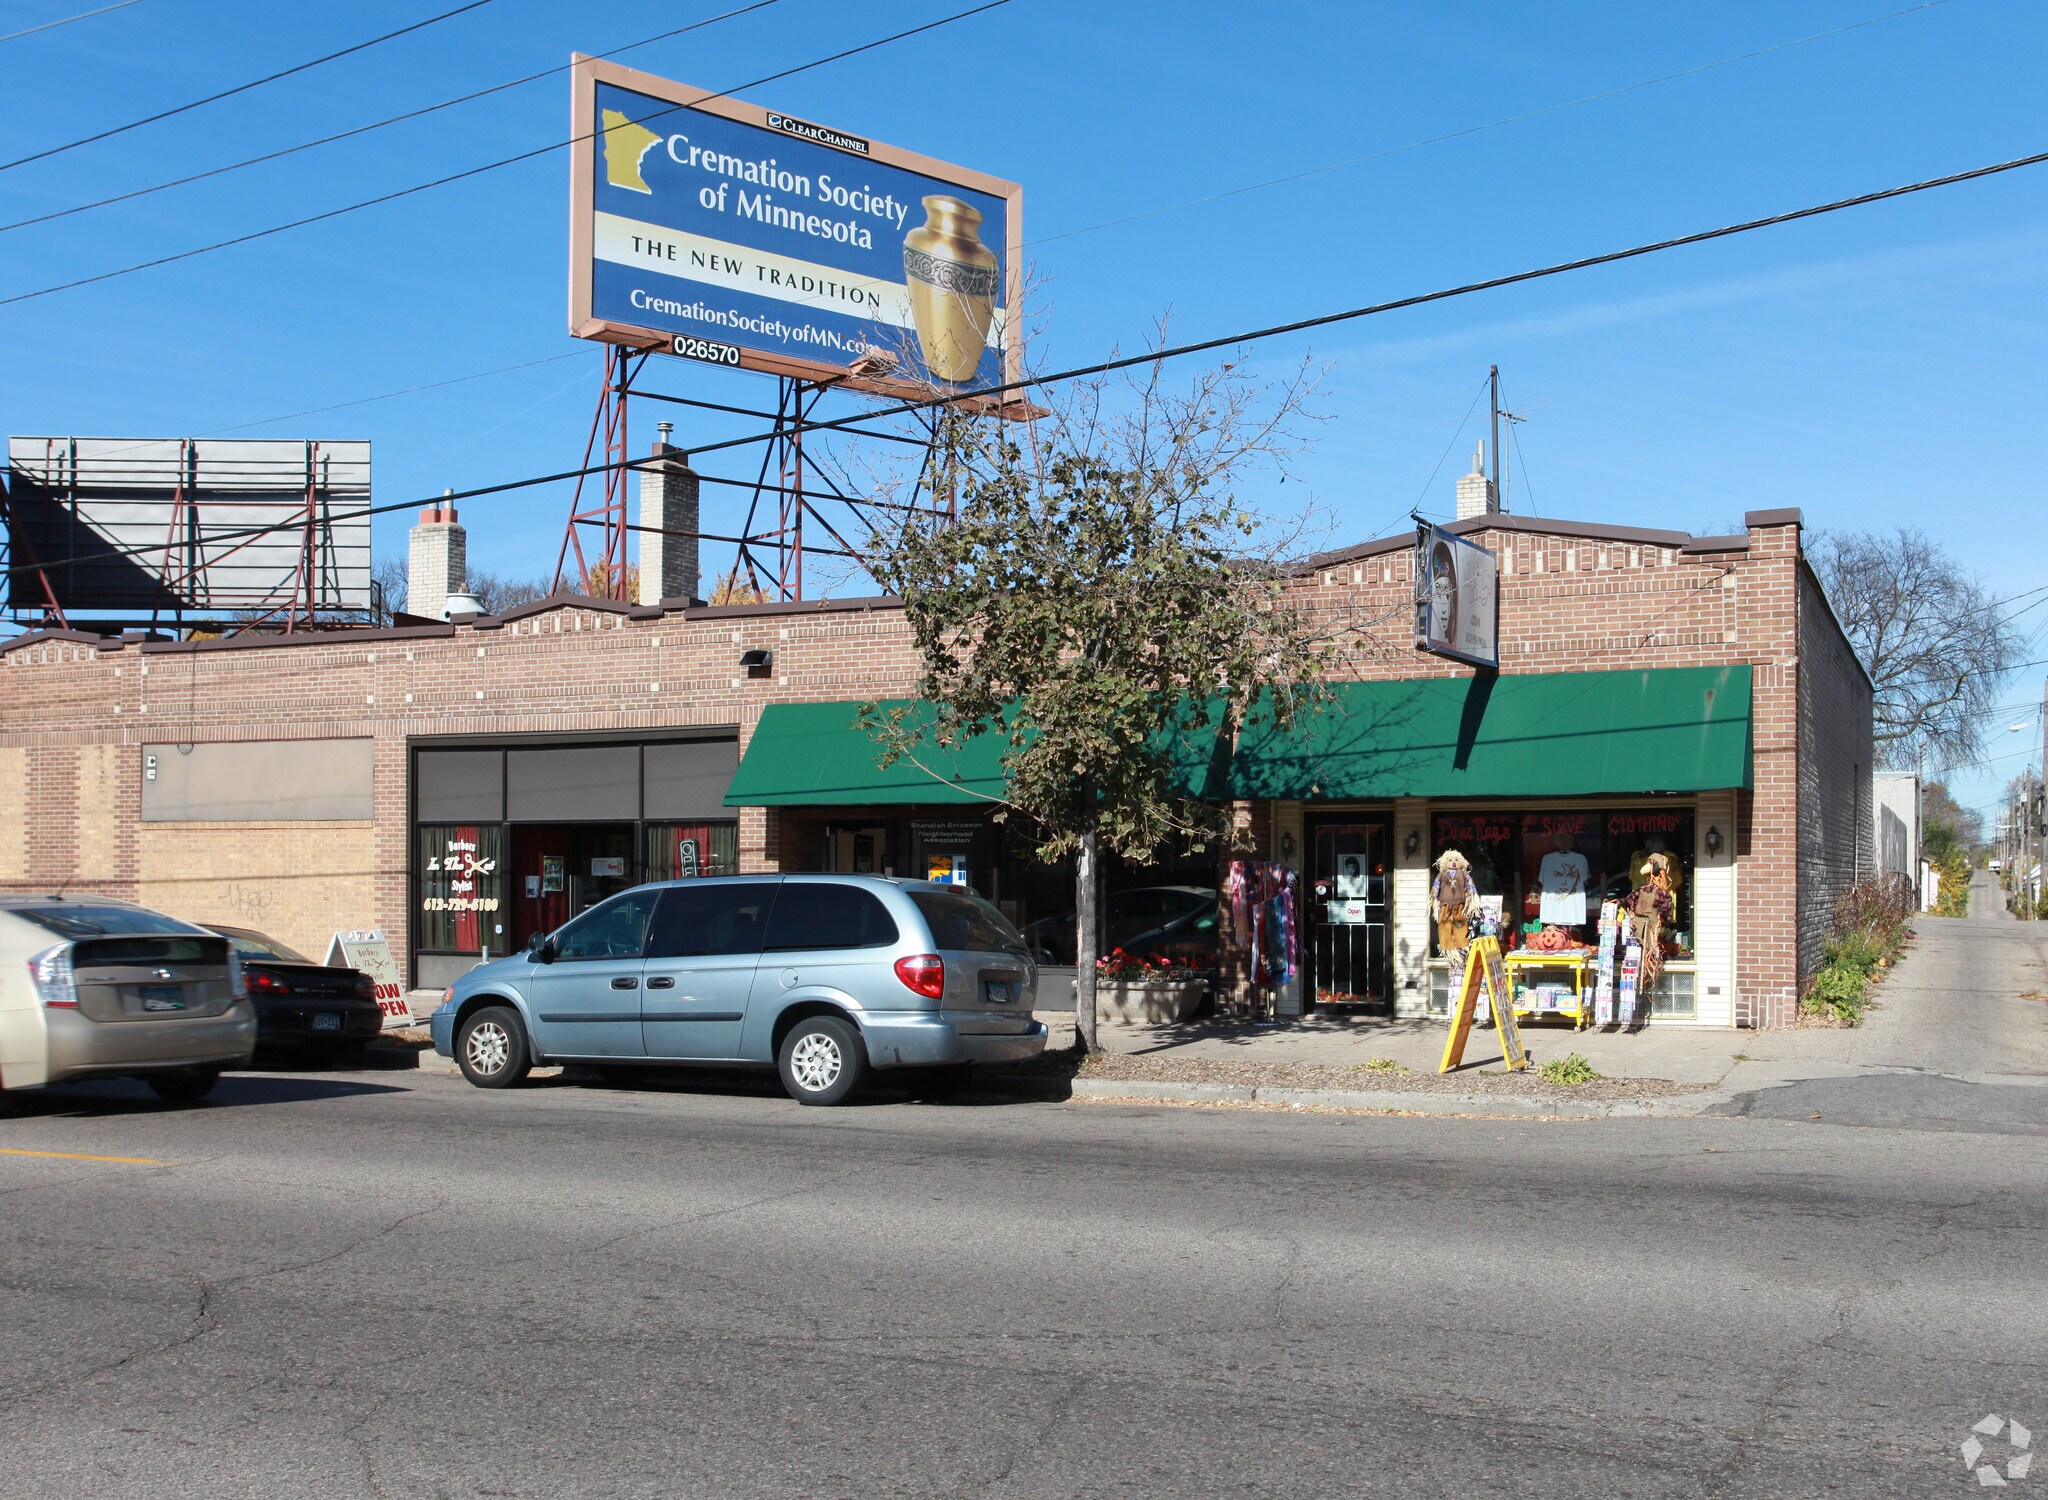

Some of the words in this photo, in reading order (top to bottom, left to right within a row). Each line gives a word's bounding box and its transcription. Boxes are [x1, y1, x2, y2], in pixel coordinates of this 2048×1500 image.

[667, 134, 811, 197] Cremation
[818, 174, 908, 231] Society
[699, 182, 729, 212] of
[736, 189, 872, 250] Minnesota
[631, 235, 677, 262] THE
[691, 250, 743, 276] NEW
[756, 265, 881, 308] TRADITION
[674, 336, 739, 365] 026570
[1607, 815, 1678, 836] CLOTHING
[448, 839, 476, 852] Barbers
[443, 856, 465, 871] The
[682, 843, 693, 877] OPE
[451, 880, 472, 893] Stylist
[423, 898, 498, 911] 612-729-5180
[375, 983, 401, 999] OW
[379, 1000, 409, 1017] PEN
